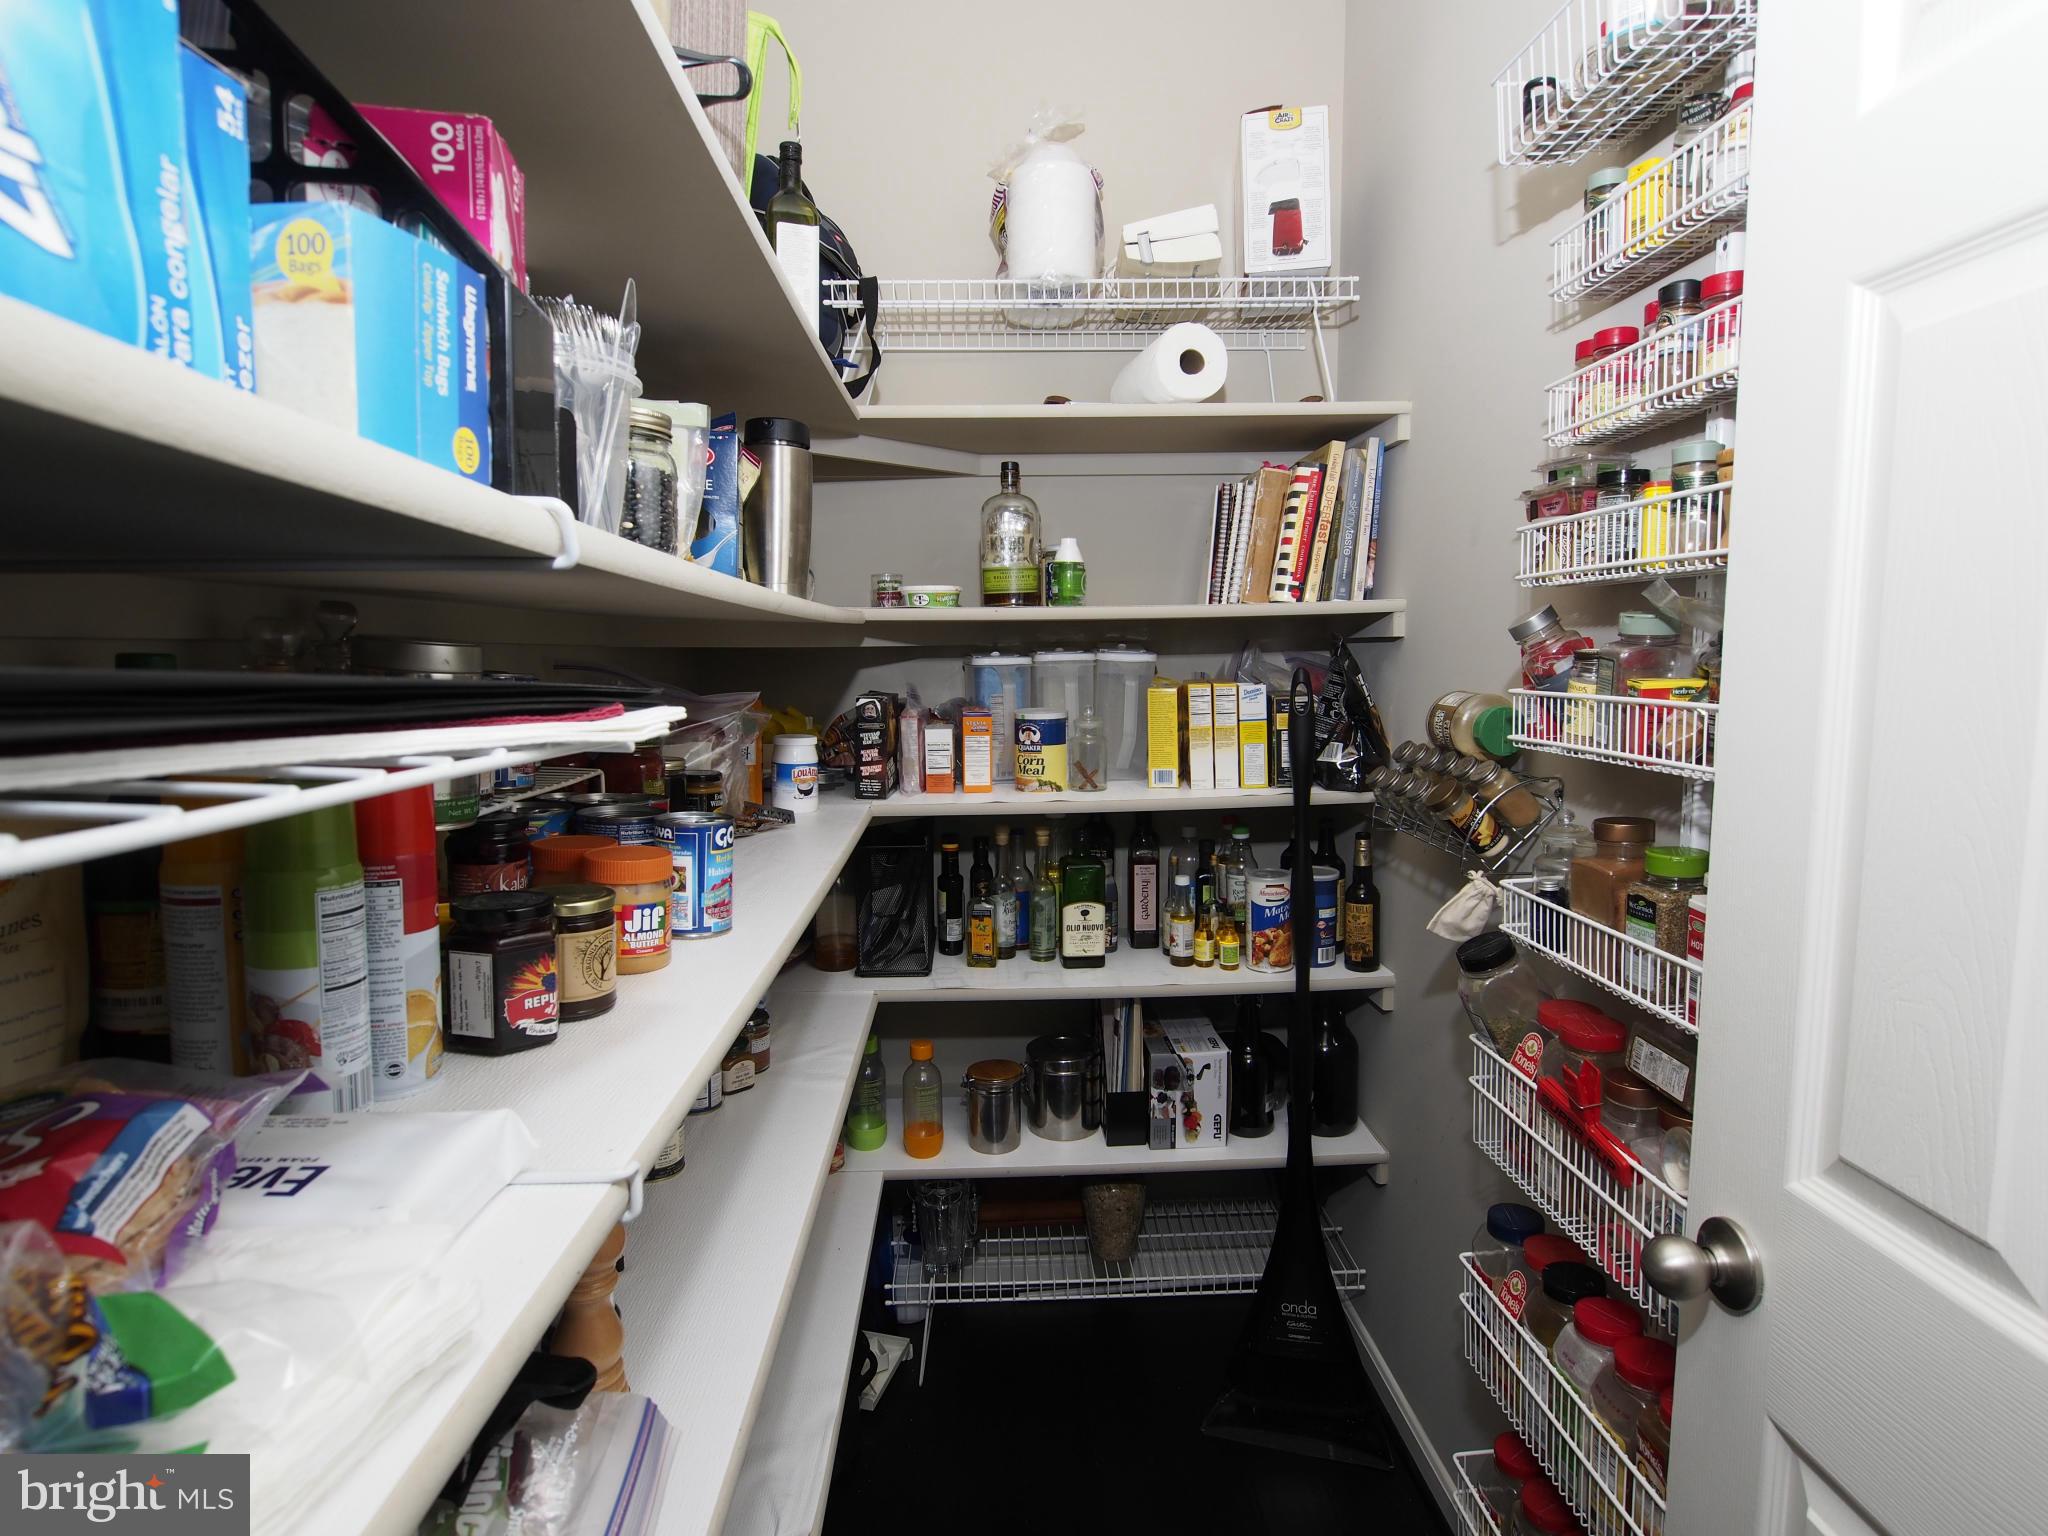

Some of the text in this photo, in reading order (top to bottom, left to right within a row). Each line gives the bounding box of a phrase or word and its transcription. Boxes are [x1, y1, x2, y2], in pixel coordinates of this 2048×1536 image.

[431, 121, 455, 174] 100
[457, 123, 465, 151] BAGS
[157, 153, 191, 299] congelar
[286, 233, 325, 255] 100
[288, 257, 322, 274] Bags
[435, 267, 450, 396] Sandwich Bags
[423, 364, 434, 388] Top
[464, 437, 475, 469] 100
[1307, 489, 1317, 514] Fannie
[1317, 485, 1336, 545] SUPERfast
[1302, 516, 1312, 542] Farmer
[1343, 500, 1358, 556] skinnytaste
[1313, 547, 1322, 574] suppers
[1017, 755, 1045, 766] Corn
[1018, 765, 1046, 776] Meal
[655, 826, 673, 840] OYA
[715, 826, 735, 848] GO
[624, 906, 664, 933] Jif
[1264, 905, 1290, 918] Matz
[1628, 901, 1653, 915] McCormick
[623, 929, 664, 942] ALMOND
[1066, 923, 1104, 932] OLIO NUOVO
[629, 938, 659, 949] BUTTER
[1691, 938, 1703, 952] HOT
[585, 943, 599, 980] VIRGINIA
[525, 994, 557, 1010] REPU
[1514, 1050, 1537, 1074] Tone's
[1213, 1113, 1222, 1140] GEFU
[1281, 1299, 1317, 1315] onda
[1500, 1286, 1520, 1314] Tone's
